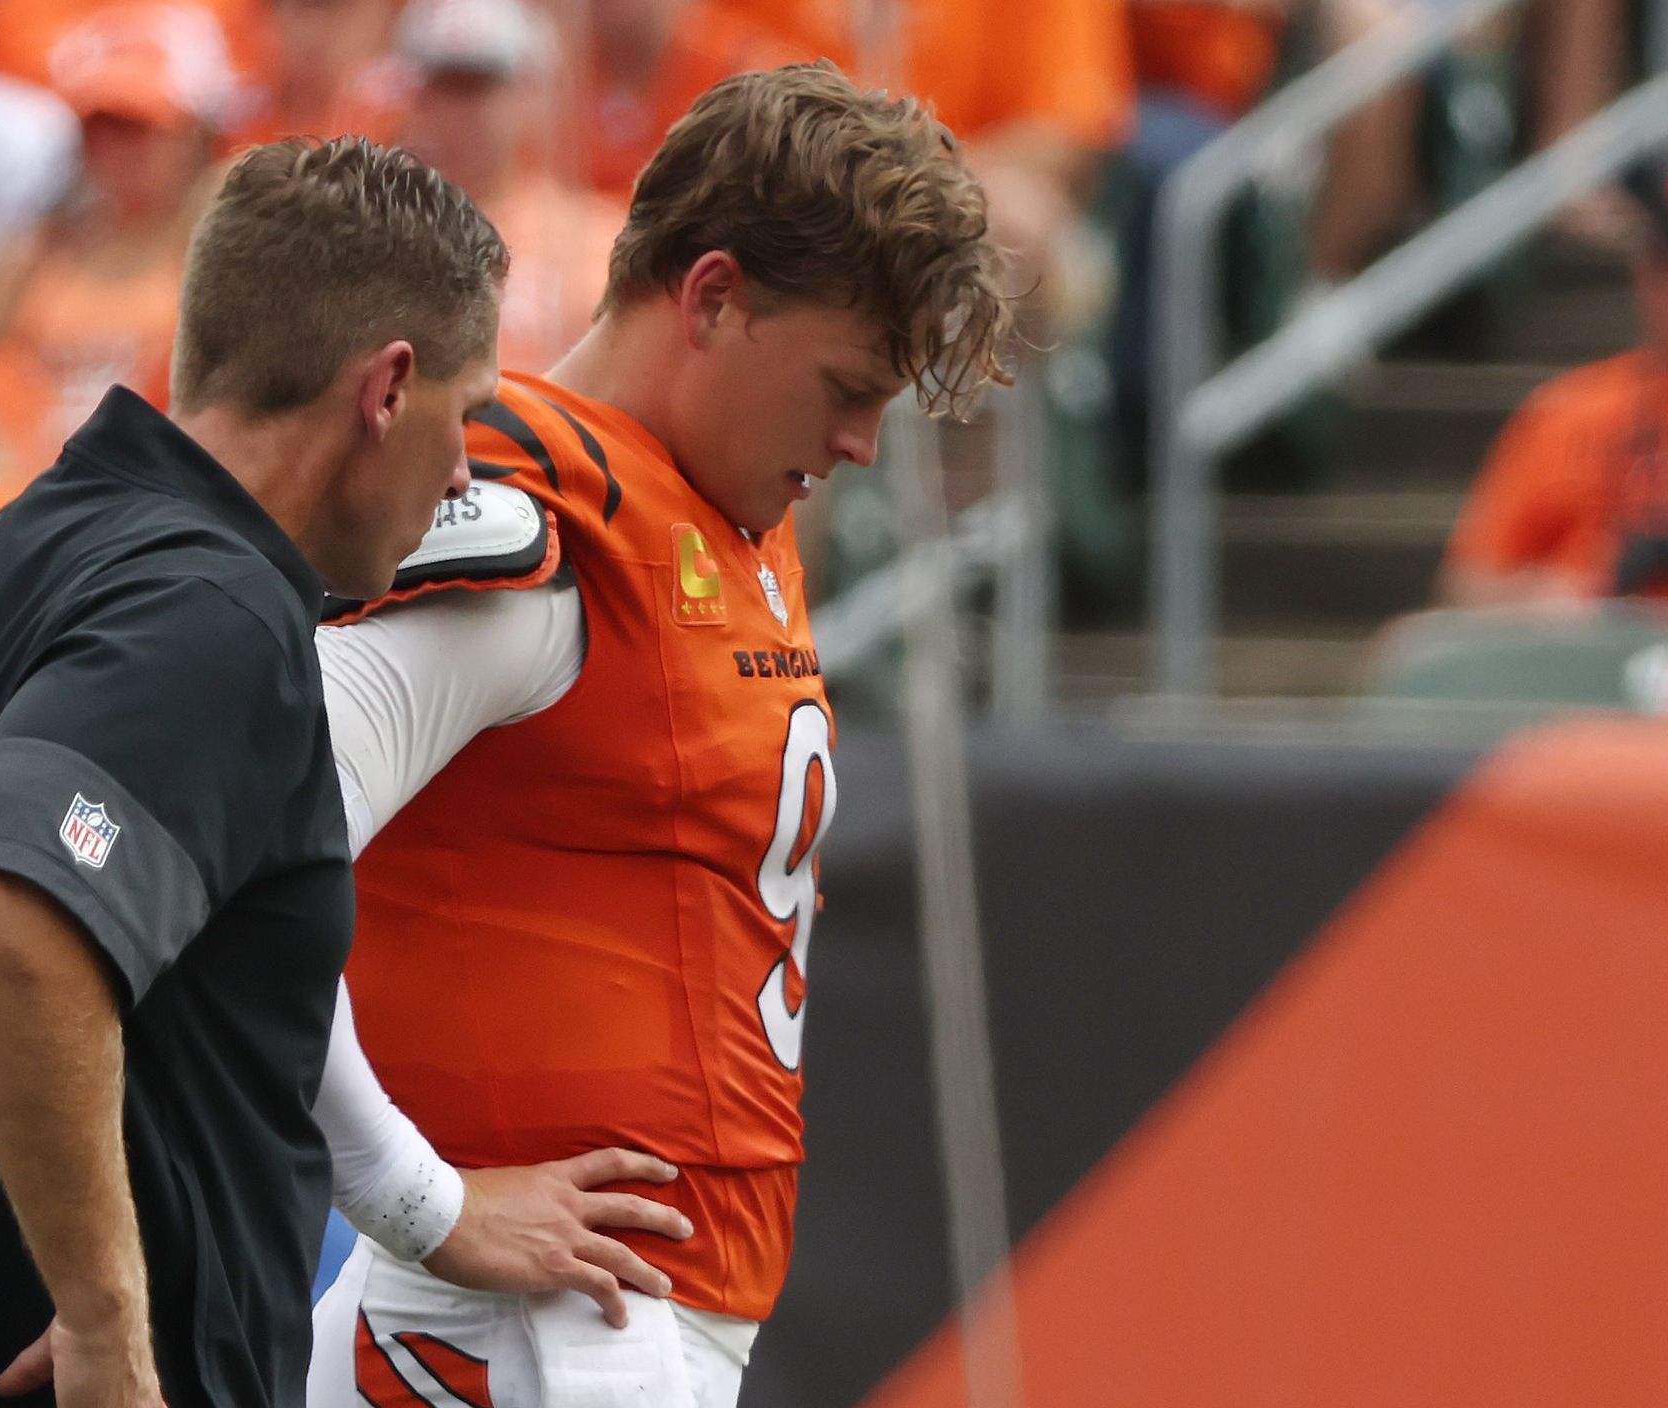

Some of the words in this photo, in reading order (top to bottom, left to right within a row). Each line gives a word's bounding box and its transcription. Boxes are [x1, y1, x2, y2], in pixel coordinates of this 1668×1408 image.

[734, 650, 821, 678] BENGAL
[66, 818, 102, 861] NFL
[757, 698, 837, 1072] 9
